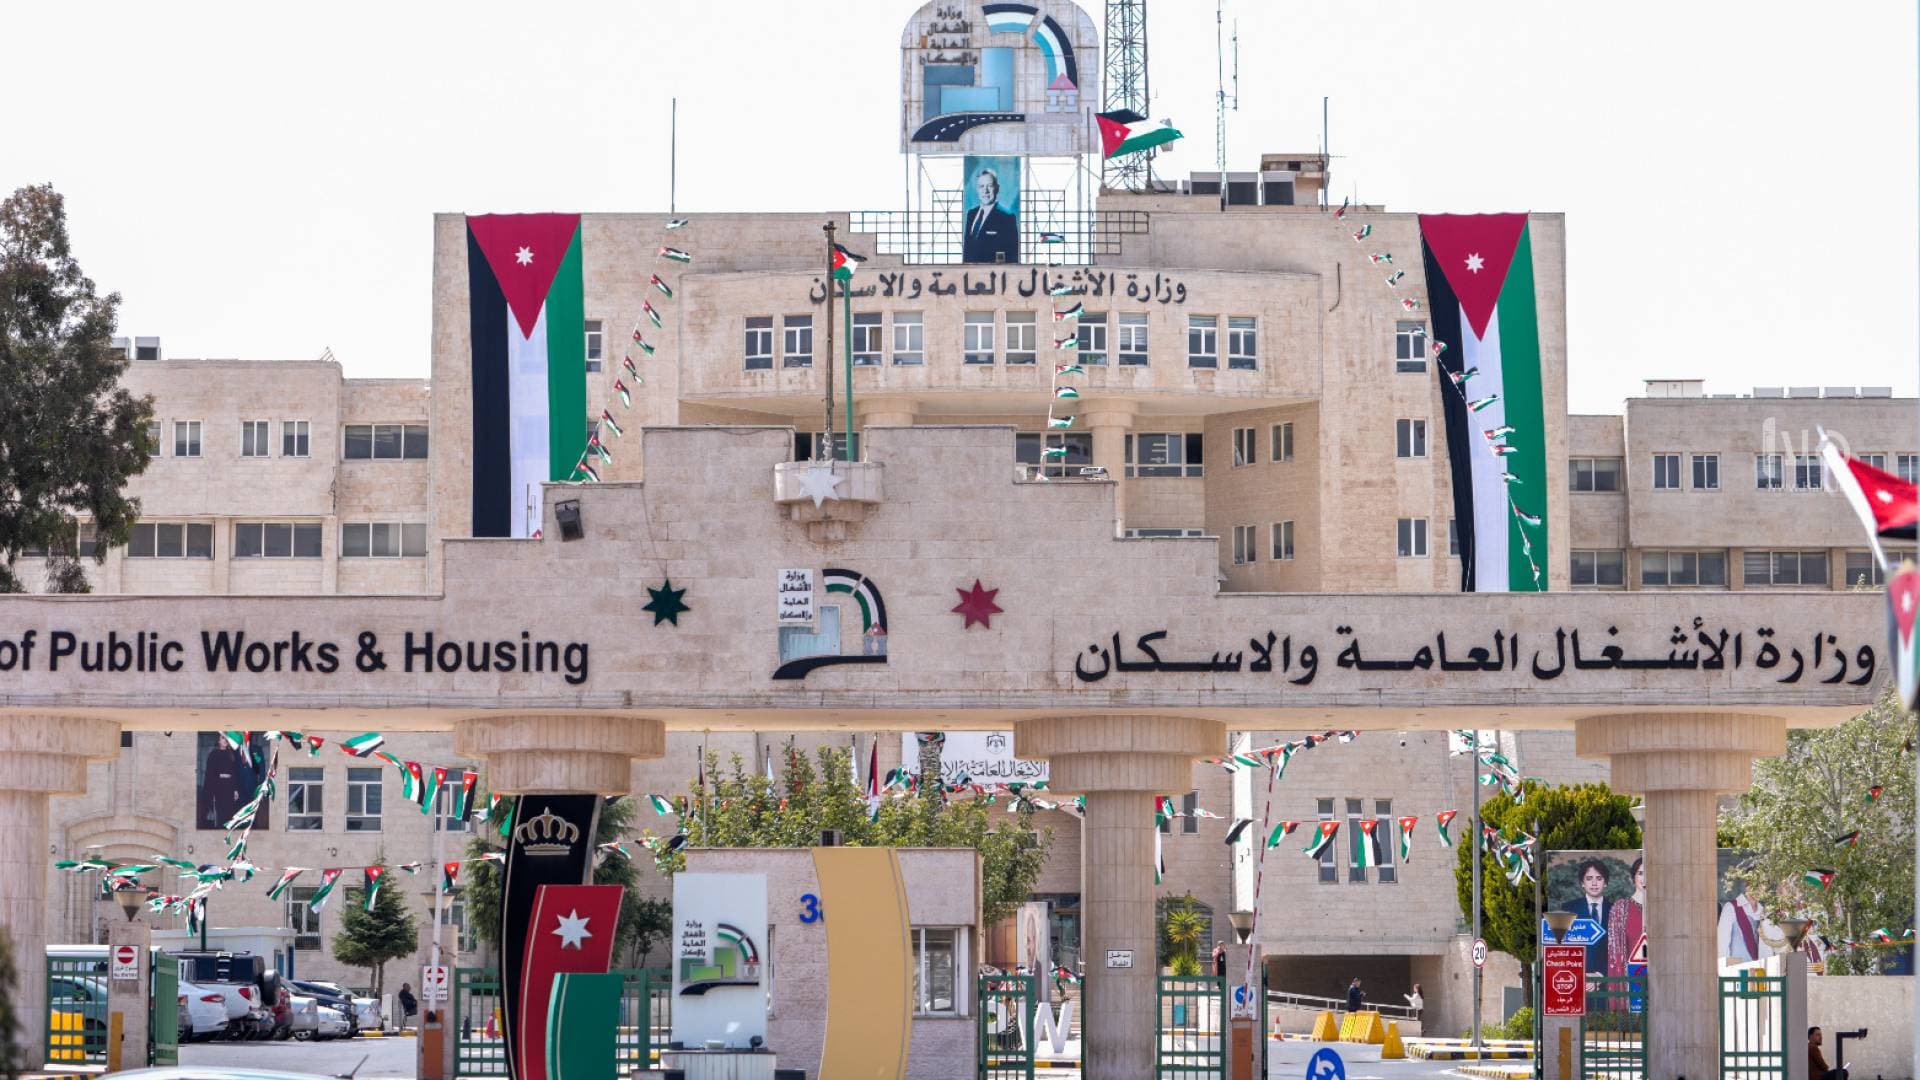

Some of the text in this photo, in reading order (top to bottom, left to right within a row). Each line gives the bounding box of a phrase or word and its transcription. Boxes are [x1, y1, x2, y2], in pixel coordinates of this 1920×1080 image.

[937, 6, 962, 20] وزارة
[930, 38, 970, 50] العامة
[928, 271, 1006, 295] العامة
[1018, 267, 1114, 297] الأشغال
[1125, 266, 1187, 304] وزارة
[785, 571, 806, 581] وزارة
[783, 597, 809, 606] العامة
[0, 631, 589, 685] of Public Works & Housing
[1075, 616, 1876, 686] وزارة الأشغال العامة والاسكان
[1475, 946, 1485, 960] 20
[1566, 960, 1583, 968] Point
